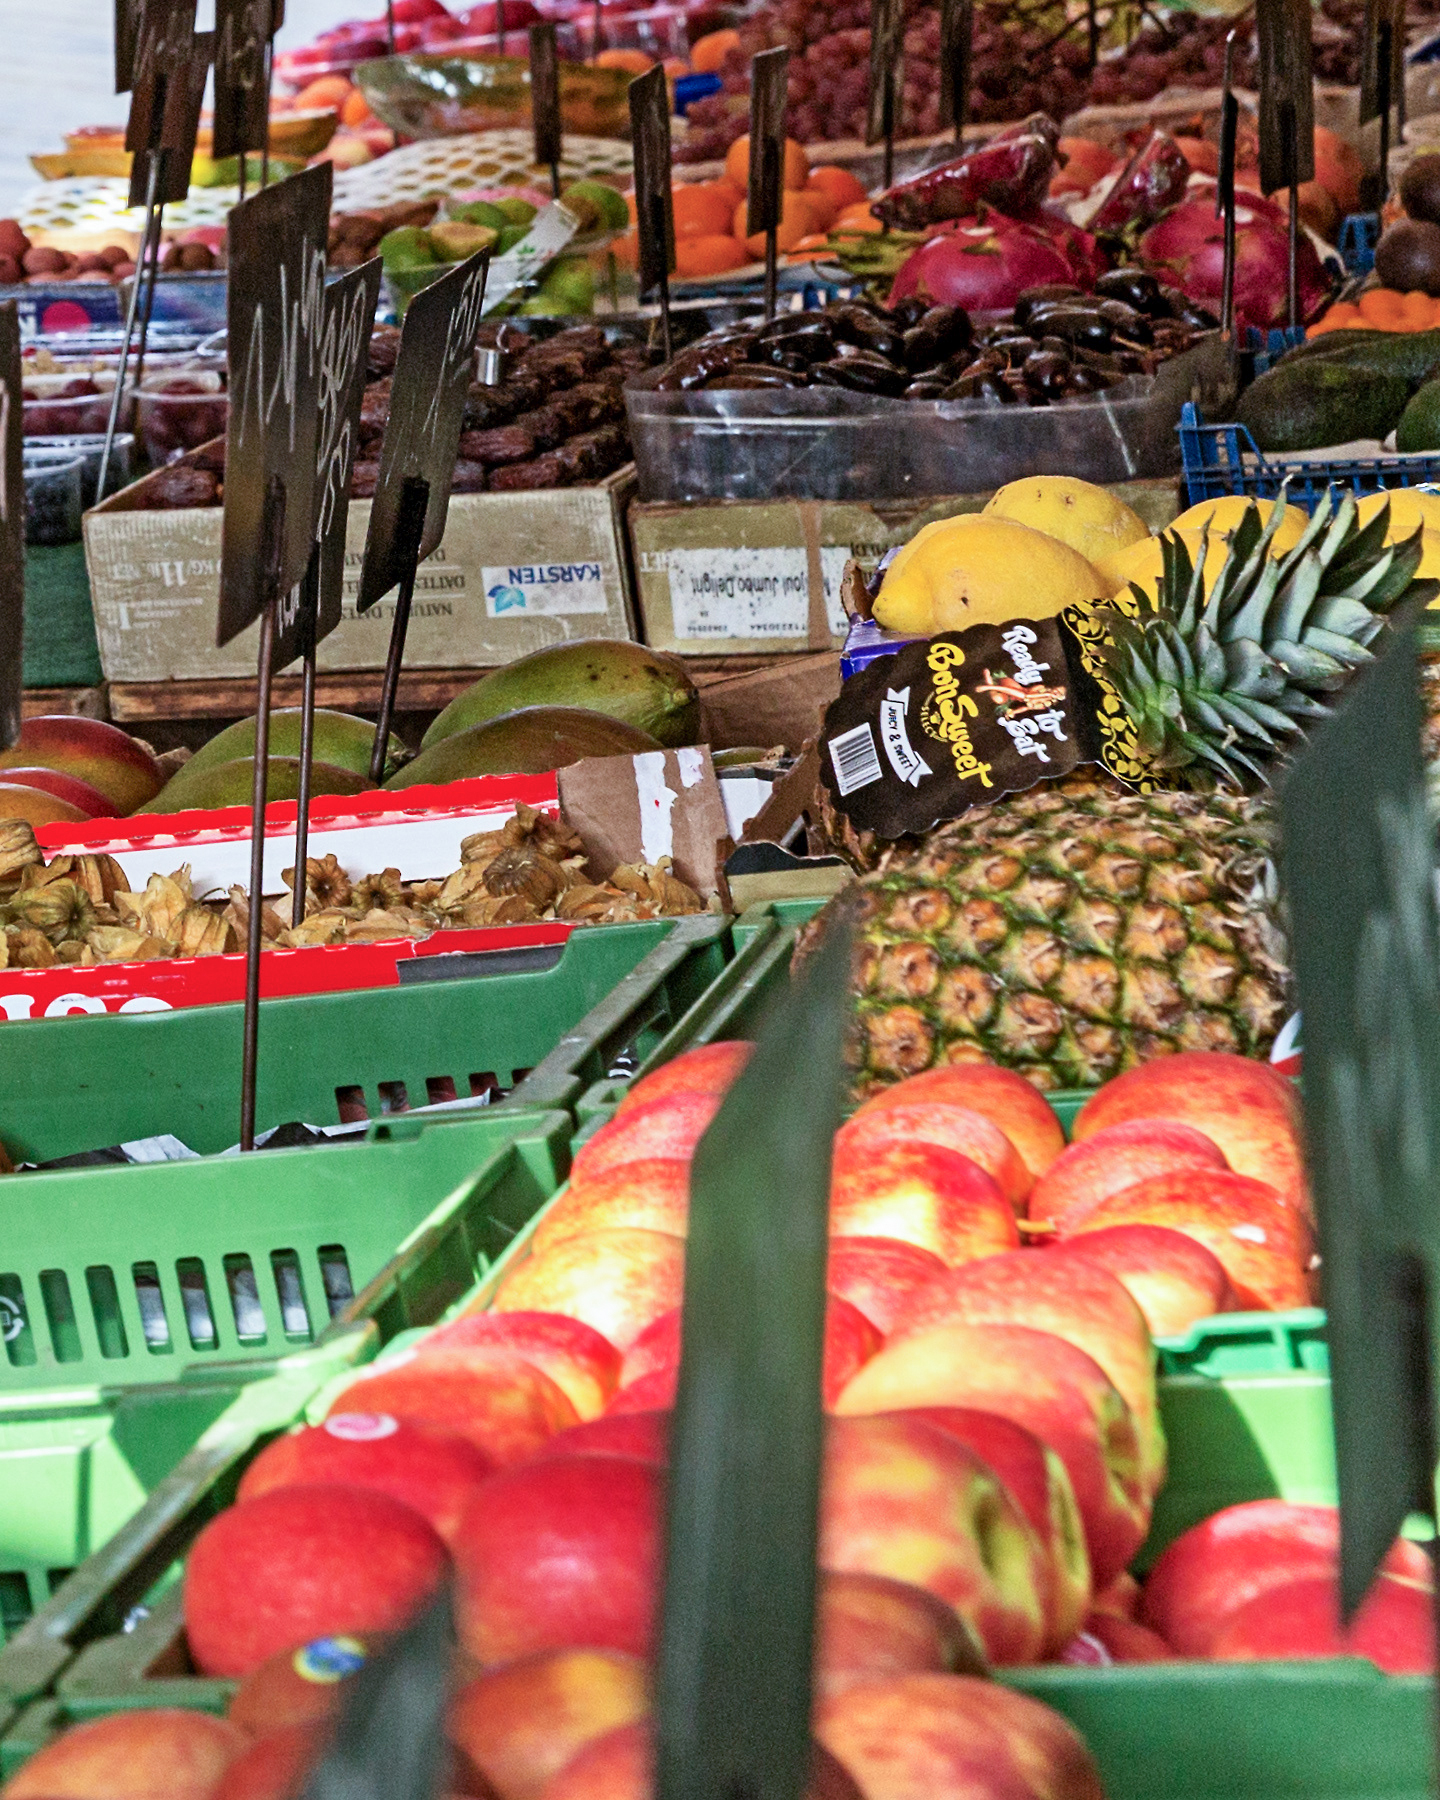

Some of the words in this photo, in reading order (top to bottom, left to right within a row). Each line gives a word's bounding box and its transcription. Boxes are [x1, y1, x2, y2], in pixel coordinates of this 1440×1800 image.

[508, 563, 601, 585] KARSTEN
[1001, 624, 1051, 686] Ready
[1033, 708, 1069, 742] to
[926, 642, 994, 789] BonSweet
[893, 743, 914, 770] SWEET
[996, 716, 1052, 763] Eat
